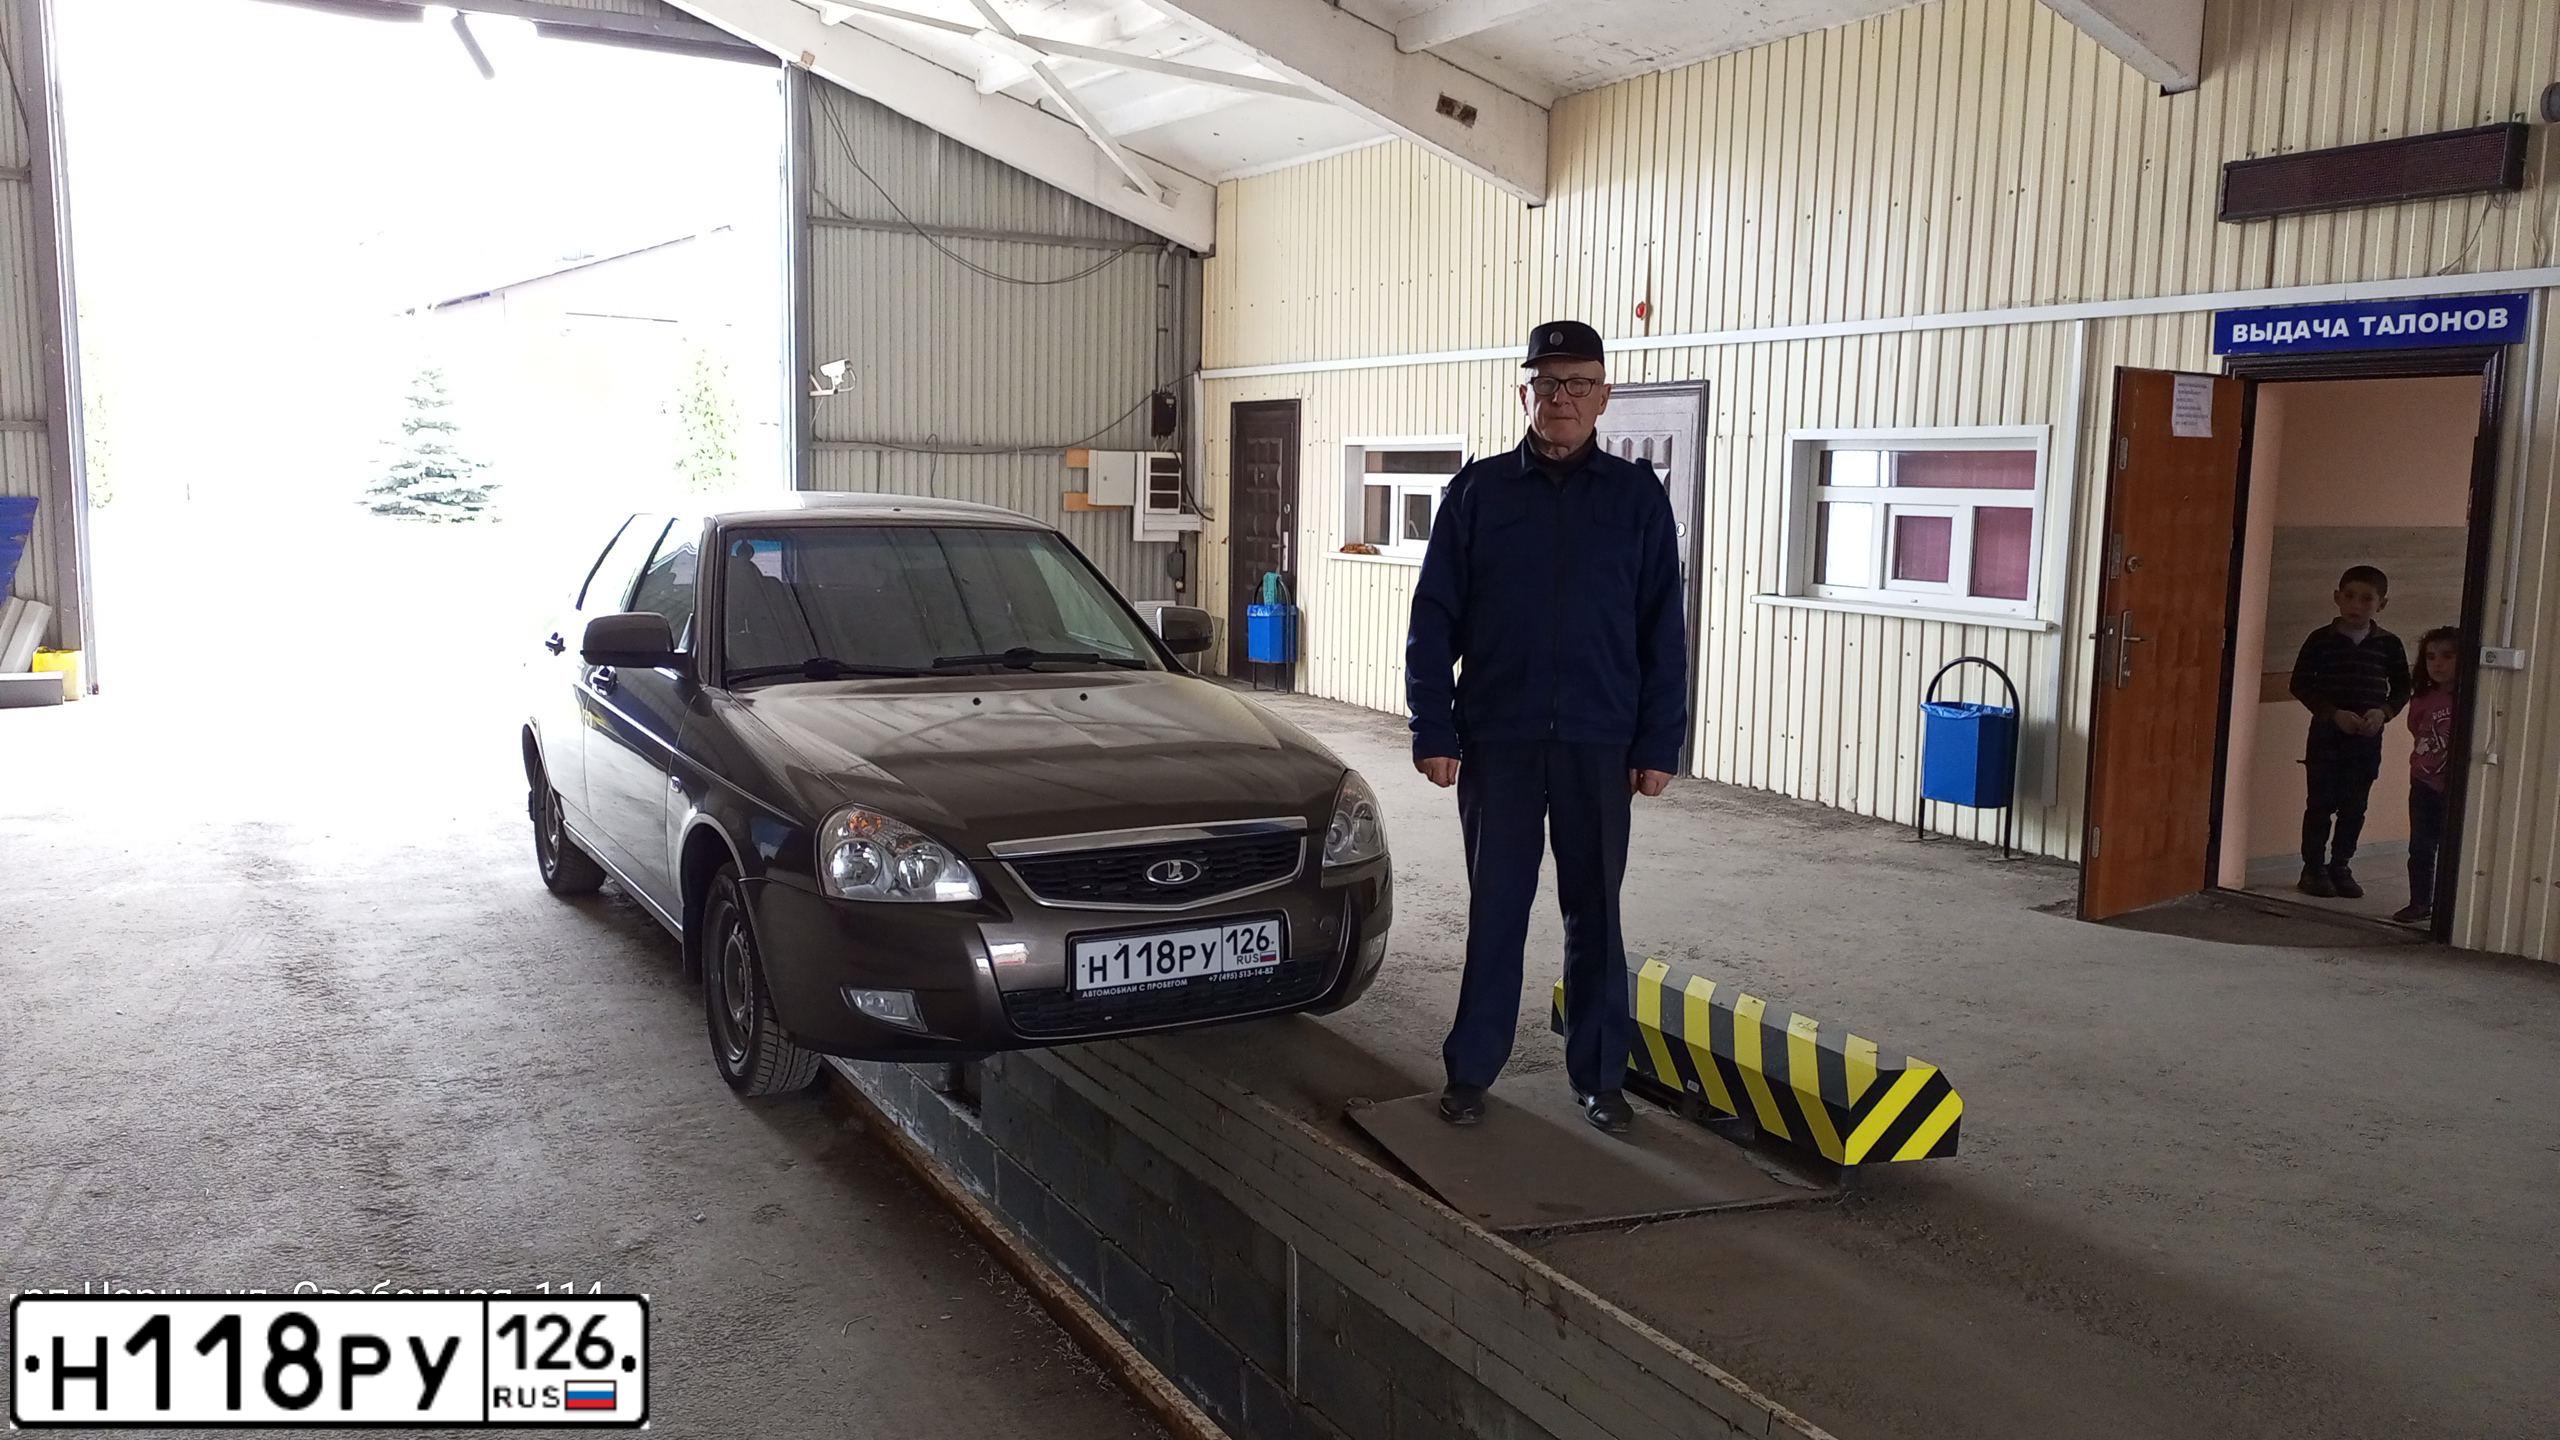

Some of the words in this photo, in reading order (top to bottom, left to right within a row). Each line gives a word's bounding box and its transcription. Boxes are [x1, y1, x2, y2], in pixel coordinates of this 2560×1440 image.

[2231, 317, 2350, 344] ВЫДАЧА
[2358, 307, 2509, 337] ТАЛОНОВ
[1089, 940, 1217, 984] Н118РУ
[1225, 925, 1270, 956] 126
[1236, 953, 1260, 965] RUS
[1208, 974, 1218, 982] +7
[1218, 971, 1238, 982] (495)
[1082, 983, 1138, 998] АВТОМОБИЛИ
[1138, 982, 1146, 991] С
[1146, 978, 1188, 991] ПРОБЕГОМ
